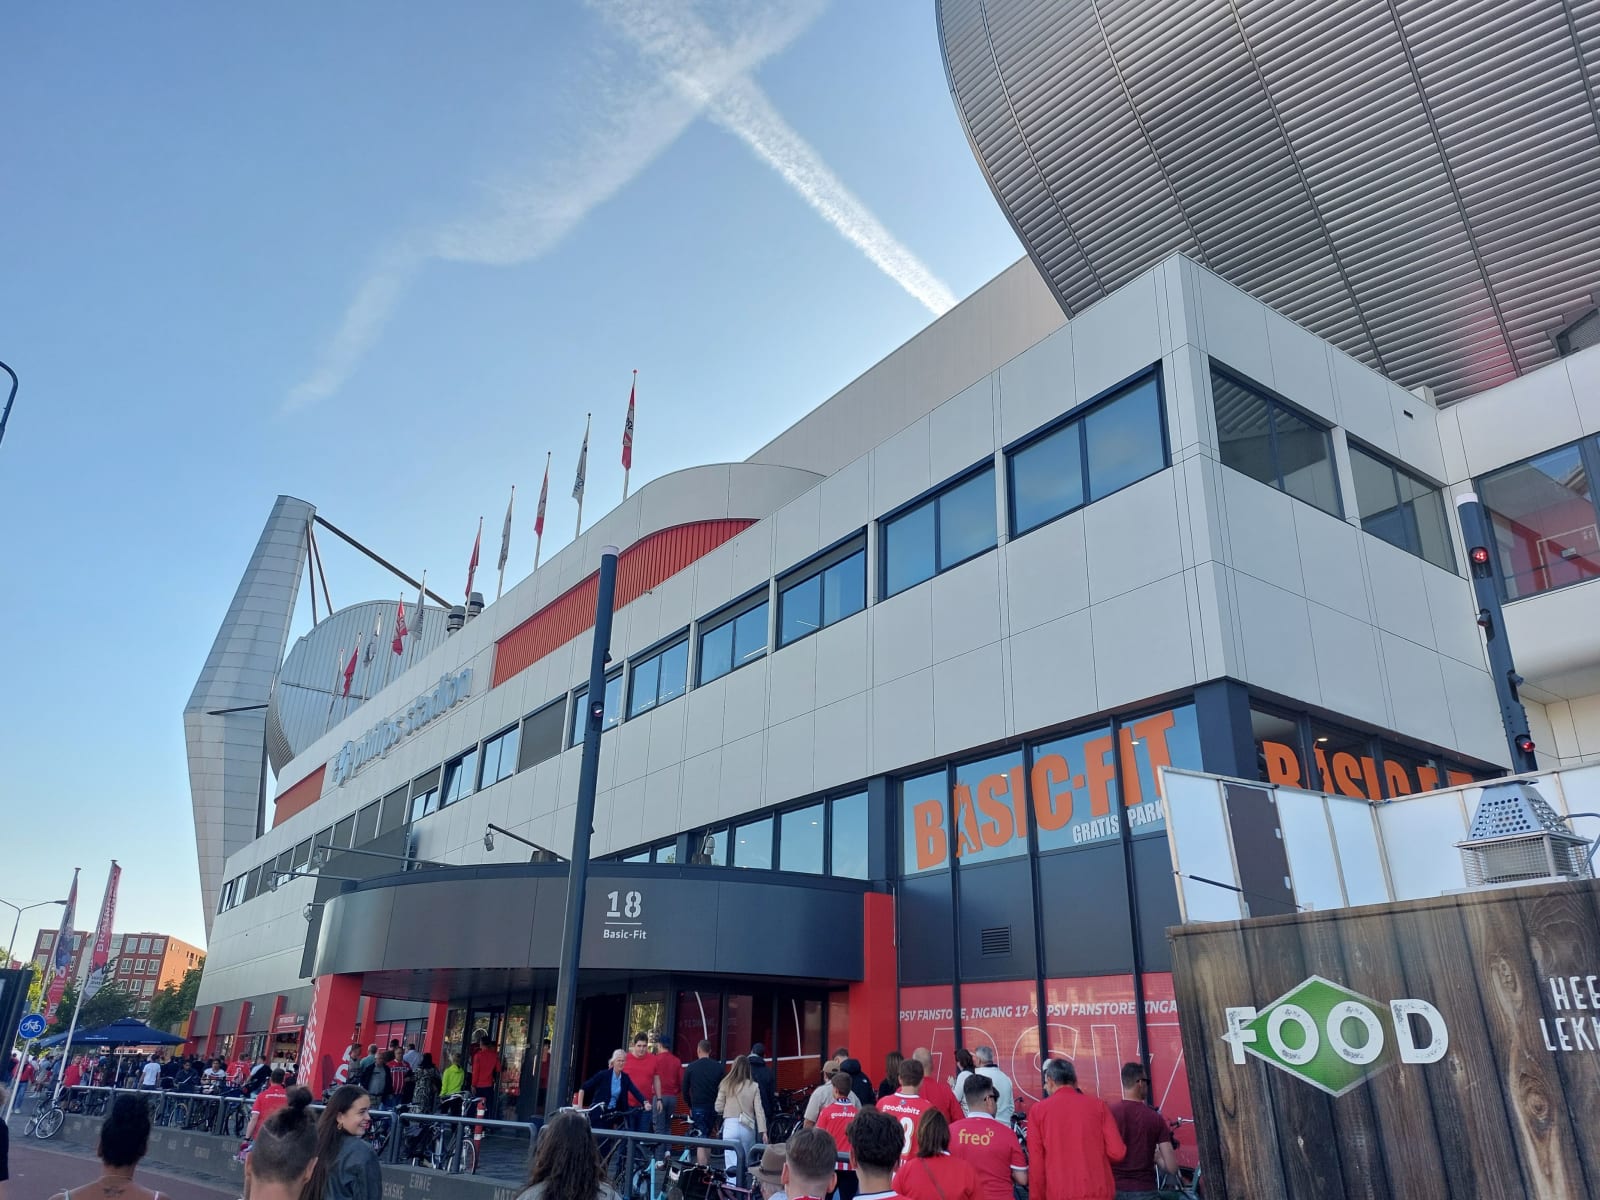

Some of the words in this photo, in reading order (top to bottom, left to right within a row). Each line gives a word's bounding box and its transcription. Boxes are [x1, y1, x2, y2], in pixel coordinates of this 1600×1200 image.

[1072, 814, 1120, 844] GRATIS
[606, 890, 642, 918] 18
[603, 929, 647, 940] Basic-Fit
[899, 1010, 916, 1023] PSV
[917, 1007, 970, 1022] FANSTOE,
[970, 1005, 1013, 1019] INGANG
[1015, 1005, 1030, 1017] 17
[1046, 1004, 1069, 1017] PSV
[1225, 998, 1449, 1066] FOOD
[882, 1104, 921, 1116] goodhabitz
